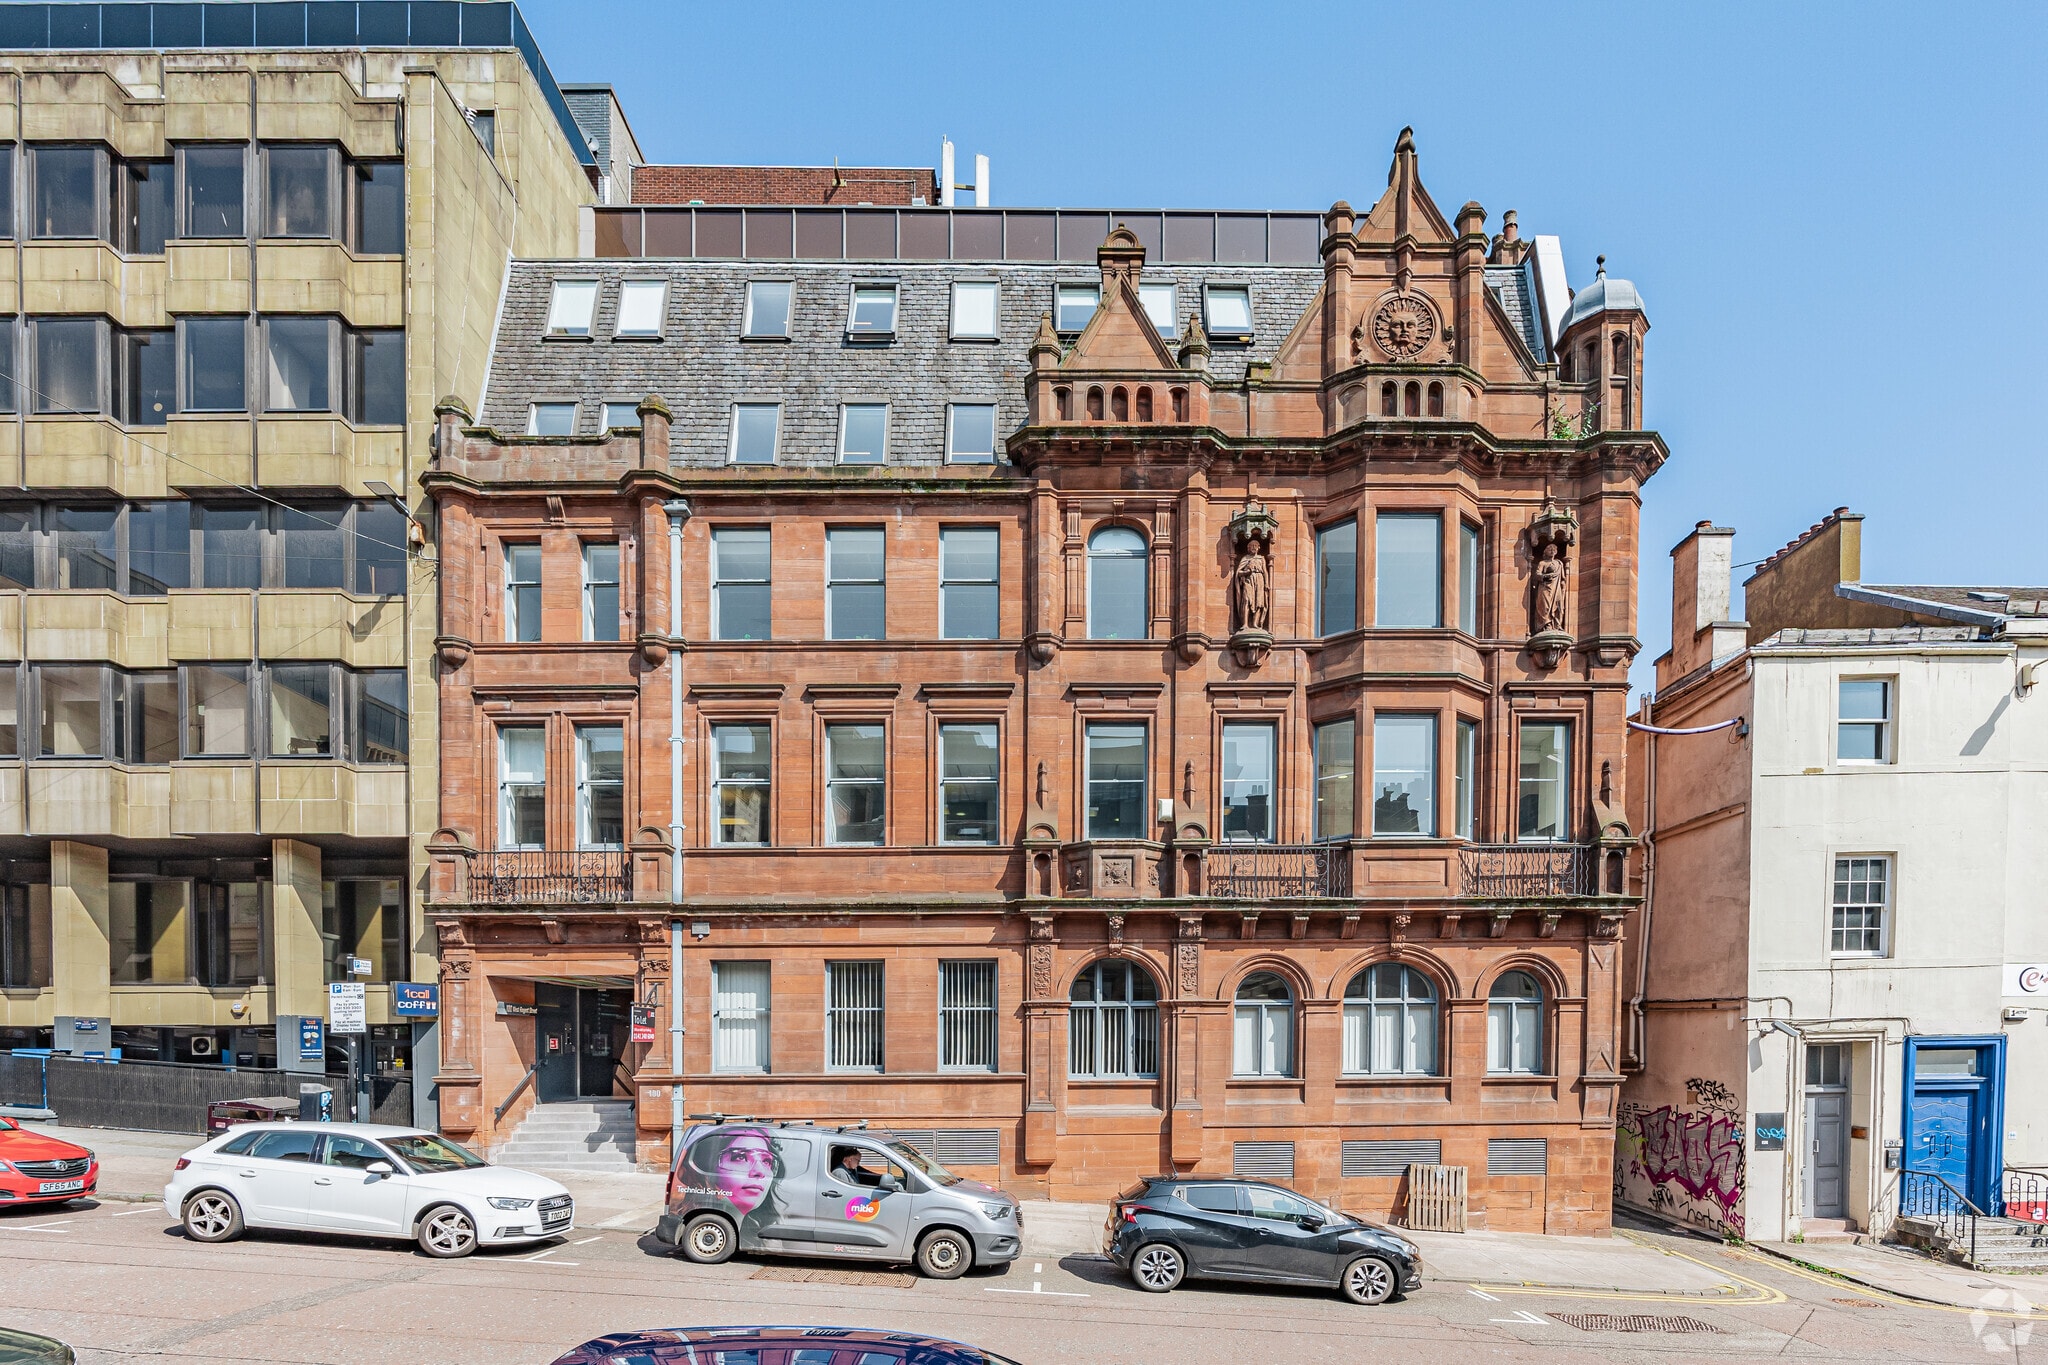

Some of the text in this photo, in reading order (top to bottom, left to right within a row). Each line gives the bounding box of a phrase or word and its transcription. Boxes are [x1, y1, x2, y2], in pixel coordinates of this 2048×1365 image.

[334, 985, 341, 993] P
[43, 1182, 66, 1191] SF65
[677, 1185, 733, 1196] Technical Services
[851, 1204, 874, 1213] mitie
